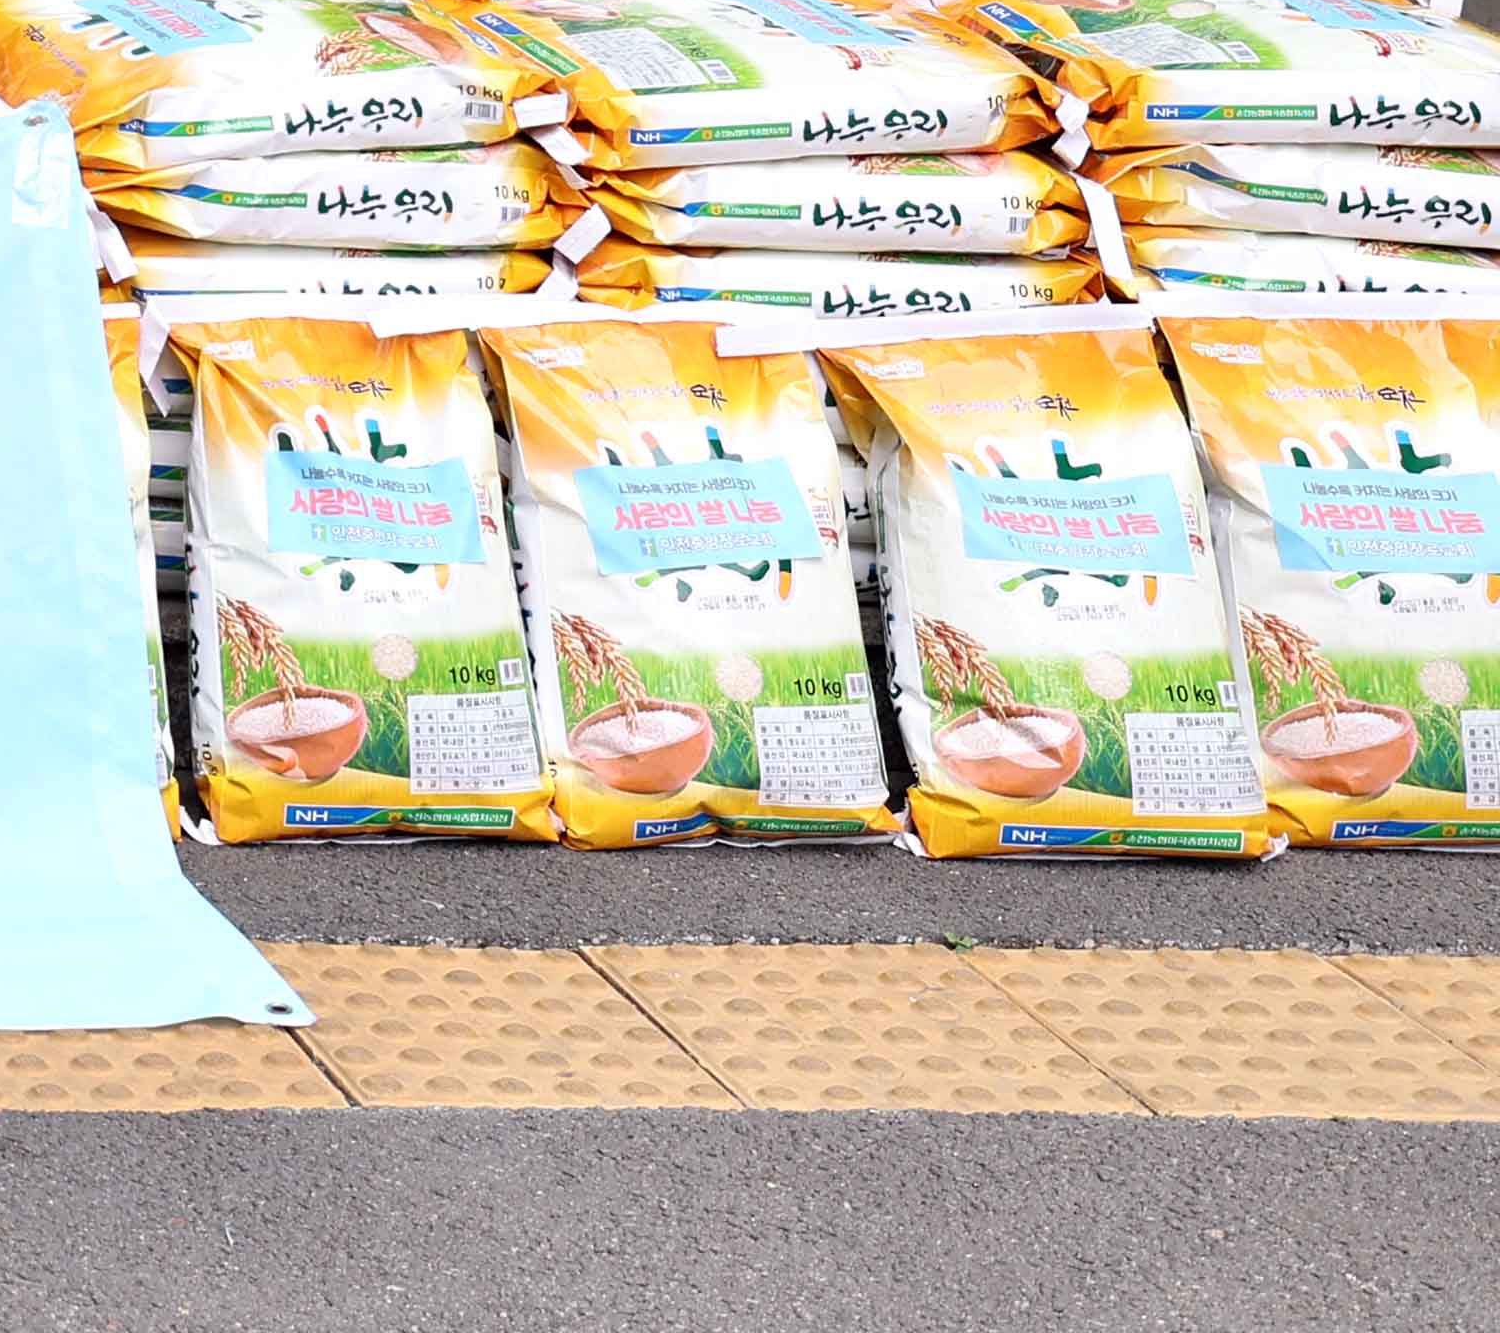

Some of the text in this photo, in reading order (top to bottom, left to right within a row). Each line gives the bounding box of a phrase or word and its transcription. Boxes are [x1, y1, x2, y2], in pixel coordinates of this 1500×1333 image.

[289, 488, 453, 527] 사랑의 쌀 나눔
[1300, 502, 1485, 534] 사랑의 쌀 나눔
[983, 506, 1160, 539] 사랑의 쌀 나눔
[449, 665, 496, 685] 10 kg
[1164, 684, 1216, 706] 10 kg
[295, 810, 329, 823] NH
[1011, 829, 1048, 842] NH
